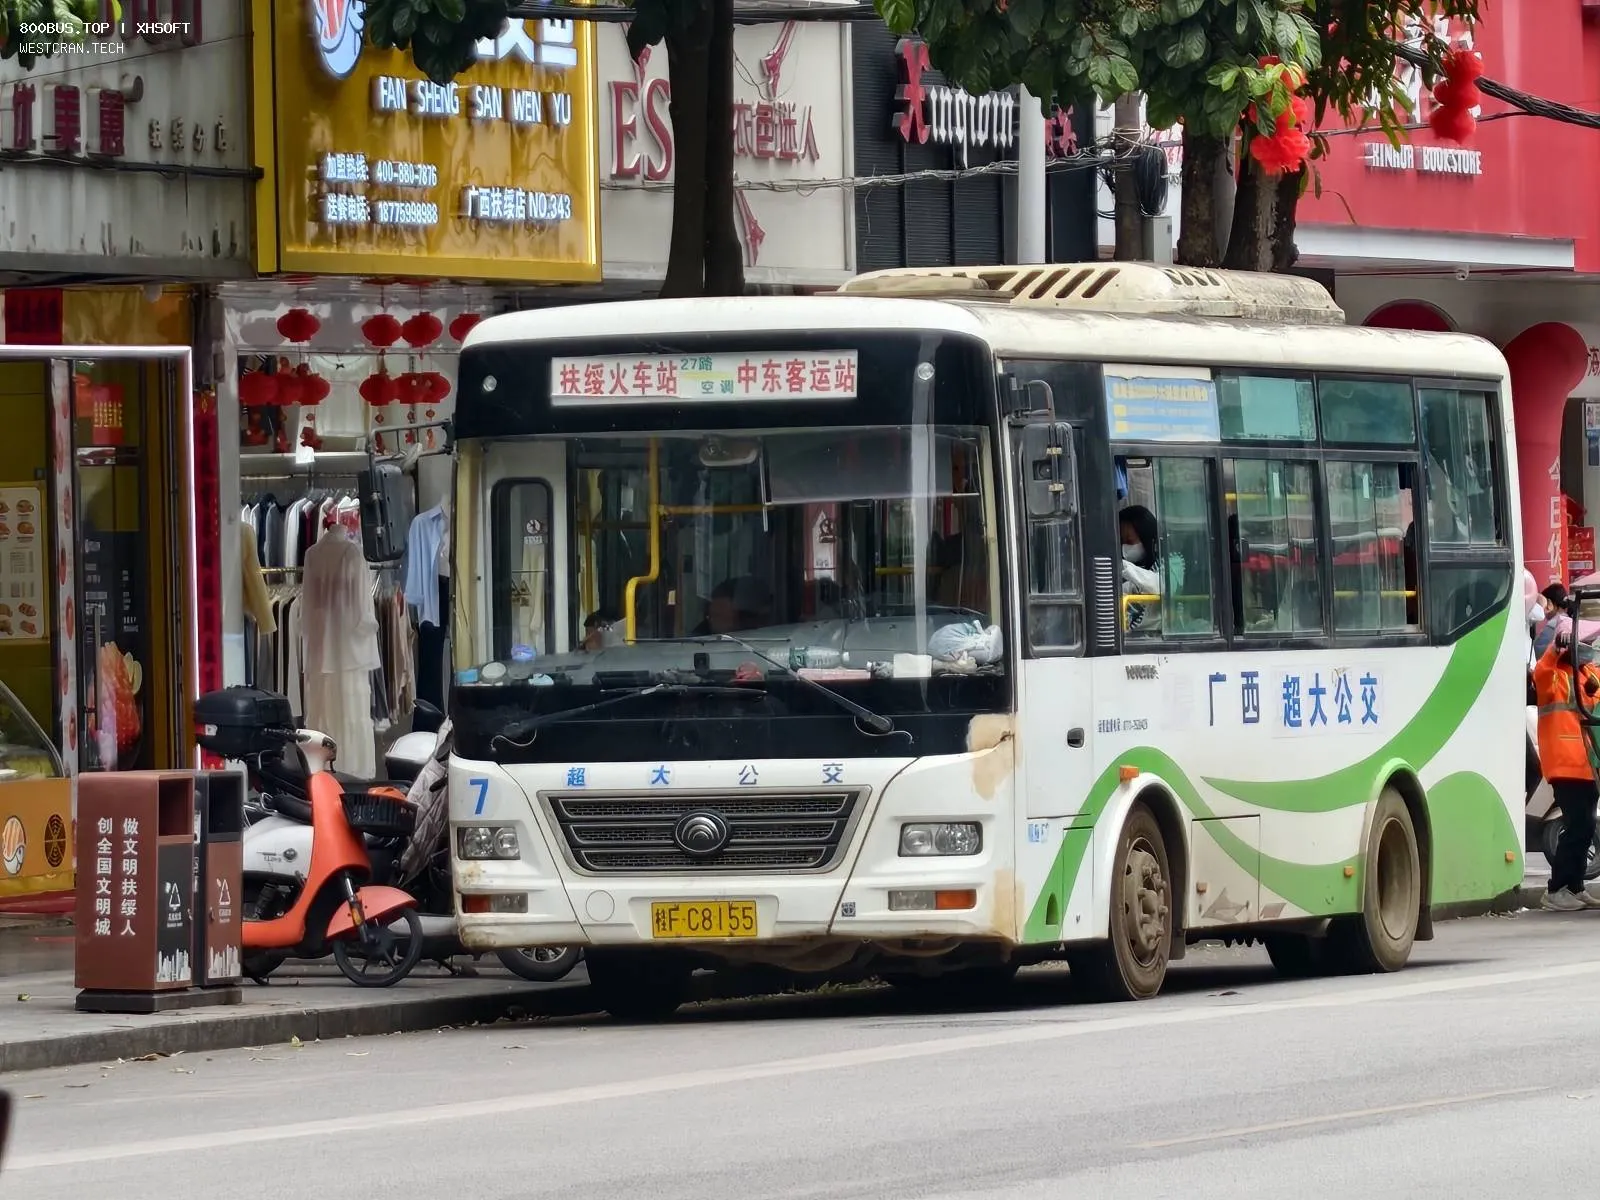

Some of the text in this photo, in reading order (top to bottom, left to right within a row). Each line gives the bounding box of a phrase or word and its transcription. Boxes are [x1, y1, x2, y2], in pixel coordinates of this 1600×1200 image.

[380, 75, 572, 125] FAN SHENG SAN WEN YU
[468, 186, 572, 220] 广西扶绥店 NO.343
[559, 359, 679, 396] 扶绥火车站
[680, 355, 713, 373] 27路
[737, 358, 857, 394] 中东客运站
[701, 379, 735, 395] 空调
[1282, 671, 1379, 729] 超大公交
[566, 762, 847, 788] 超大公交
[469, 778, 489, 815] 7
[95, 817, 113, 936] 创全国文明城
[120, 817, 139, 936] 做文明扶绥人
